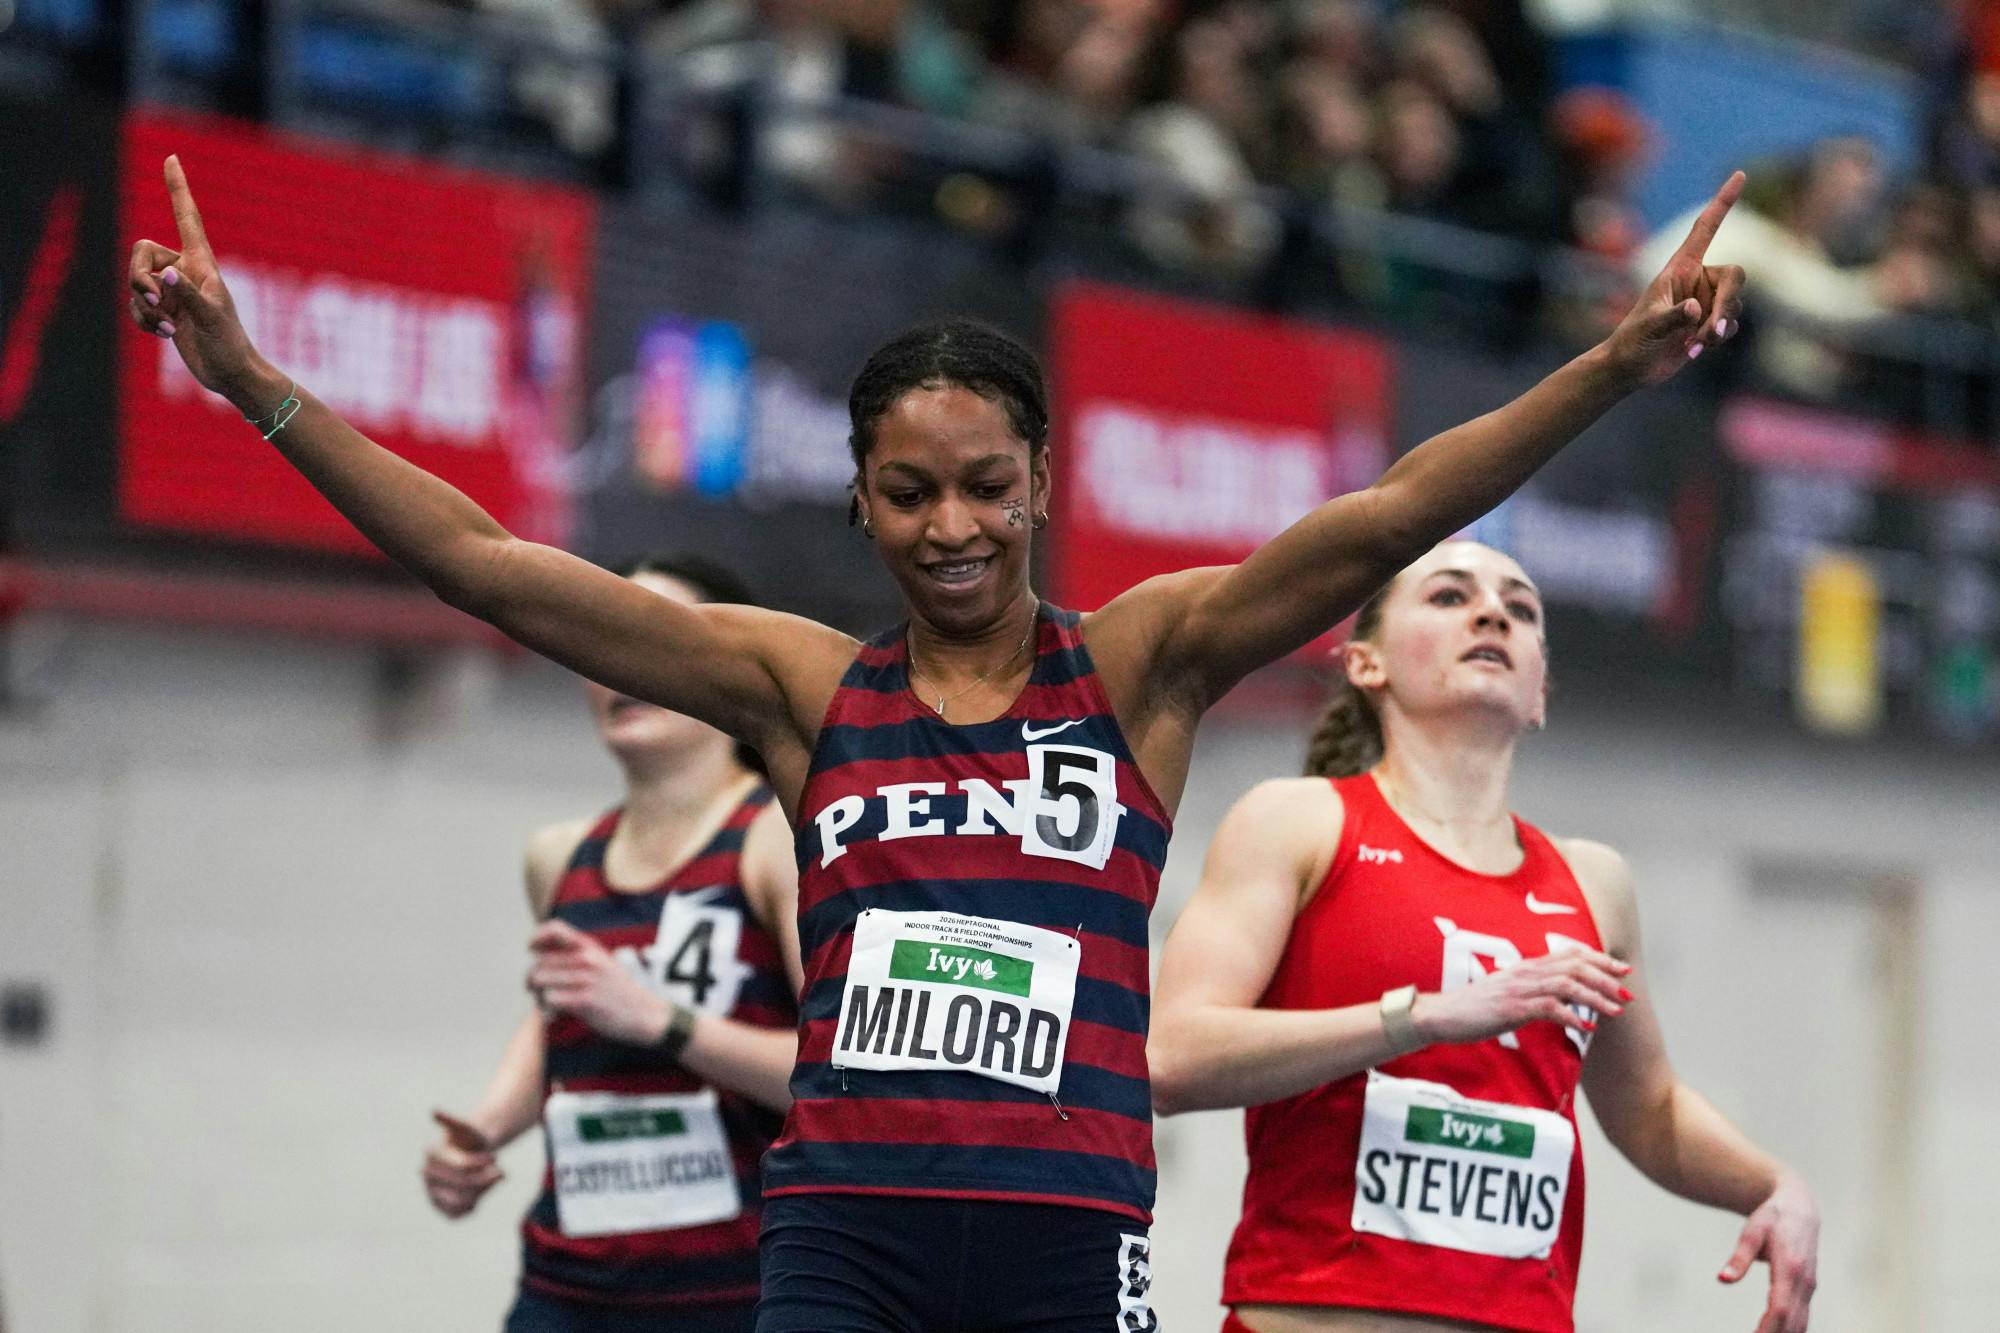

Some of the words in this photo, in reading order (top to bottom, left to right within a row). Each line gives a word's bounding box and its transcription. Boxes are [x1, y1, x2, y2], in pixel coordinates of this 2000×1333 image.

[815, 778, 1127, 870] PEN
[1036, 750, 1099, 852] 5
[904, 922, 931, 931] INDOOR
[931, 924, 953, 934] TRACK
[960, 928, 978, 936] FIELD
[978, 931, 1033, 949] CHAMPIONSHIPS
[940, 916, 956, 924] 2026
[956, 917, 1001, 931] HEPTAGONAL
[950, 936, 963, 944] THE
[964, 938, 993, 949] ARMORY
[664, 918, 717, 1006] 4
[926, 947, 974, 980] Ivy
[840, 985, 1061, 1079] MILORD
[1440, 1113, 1483, 1147] Ivy
[1362, 1149, 1560, 1232] STEVENS
